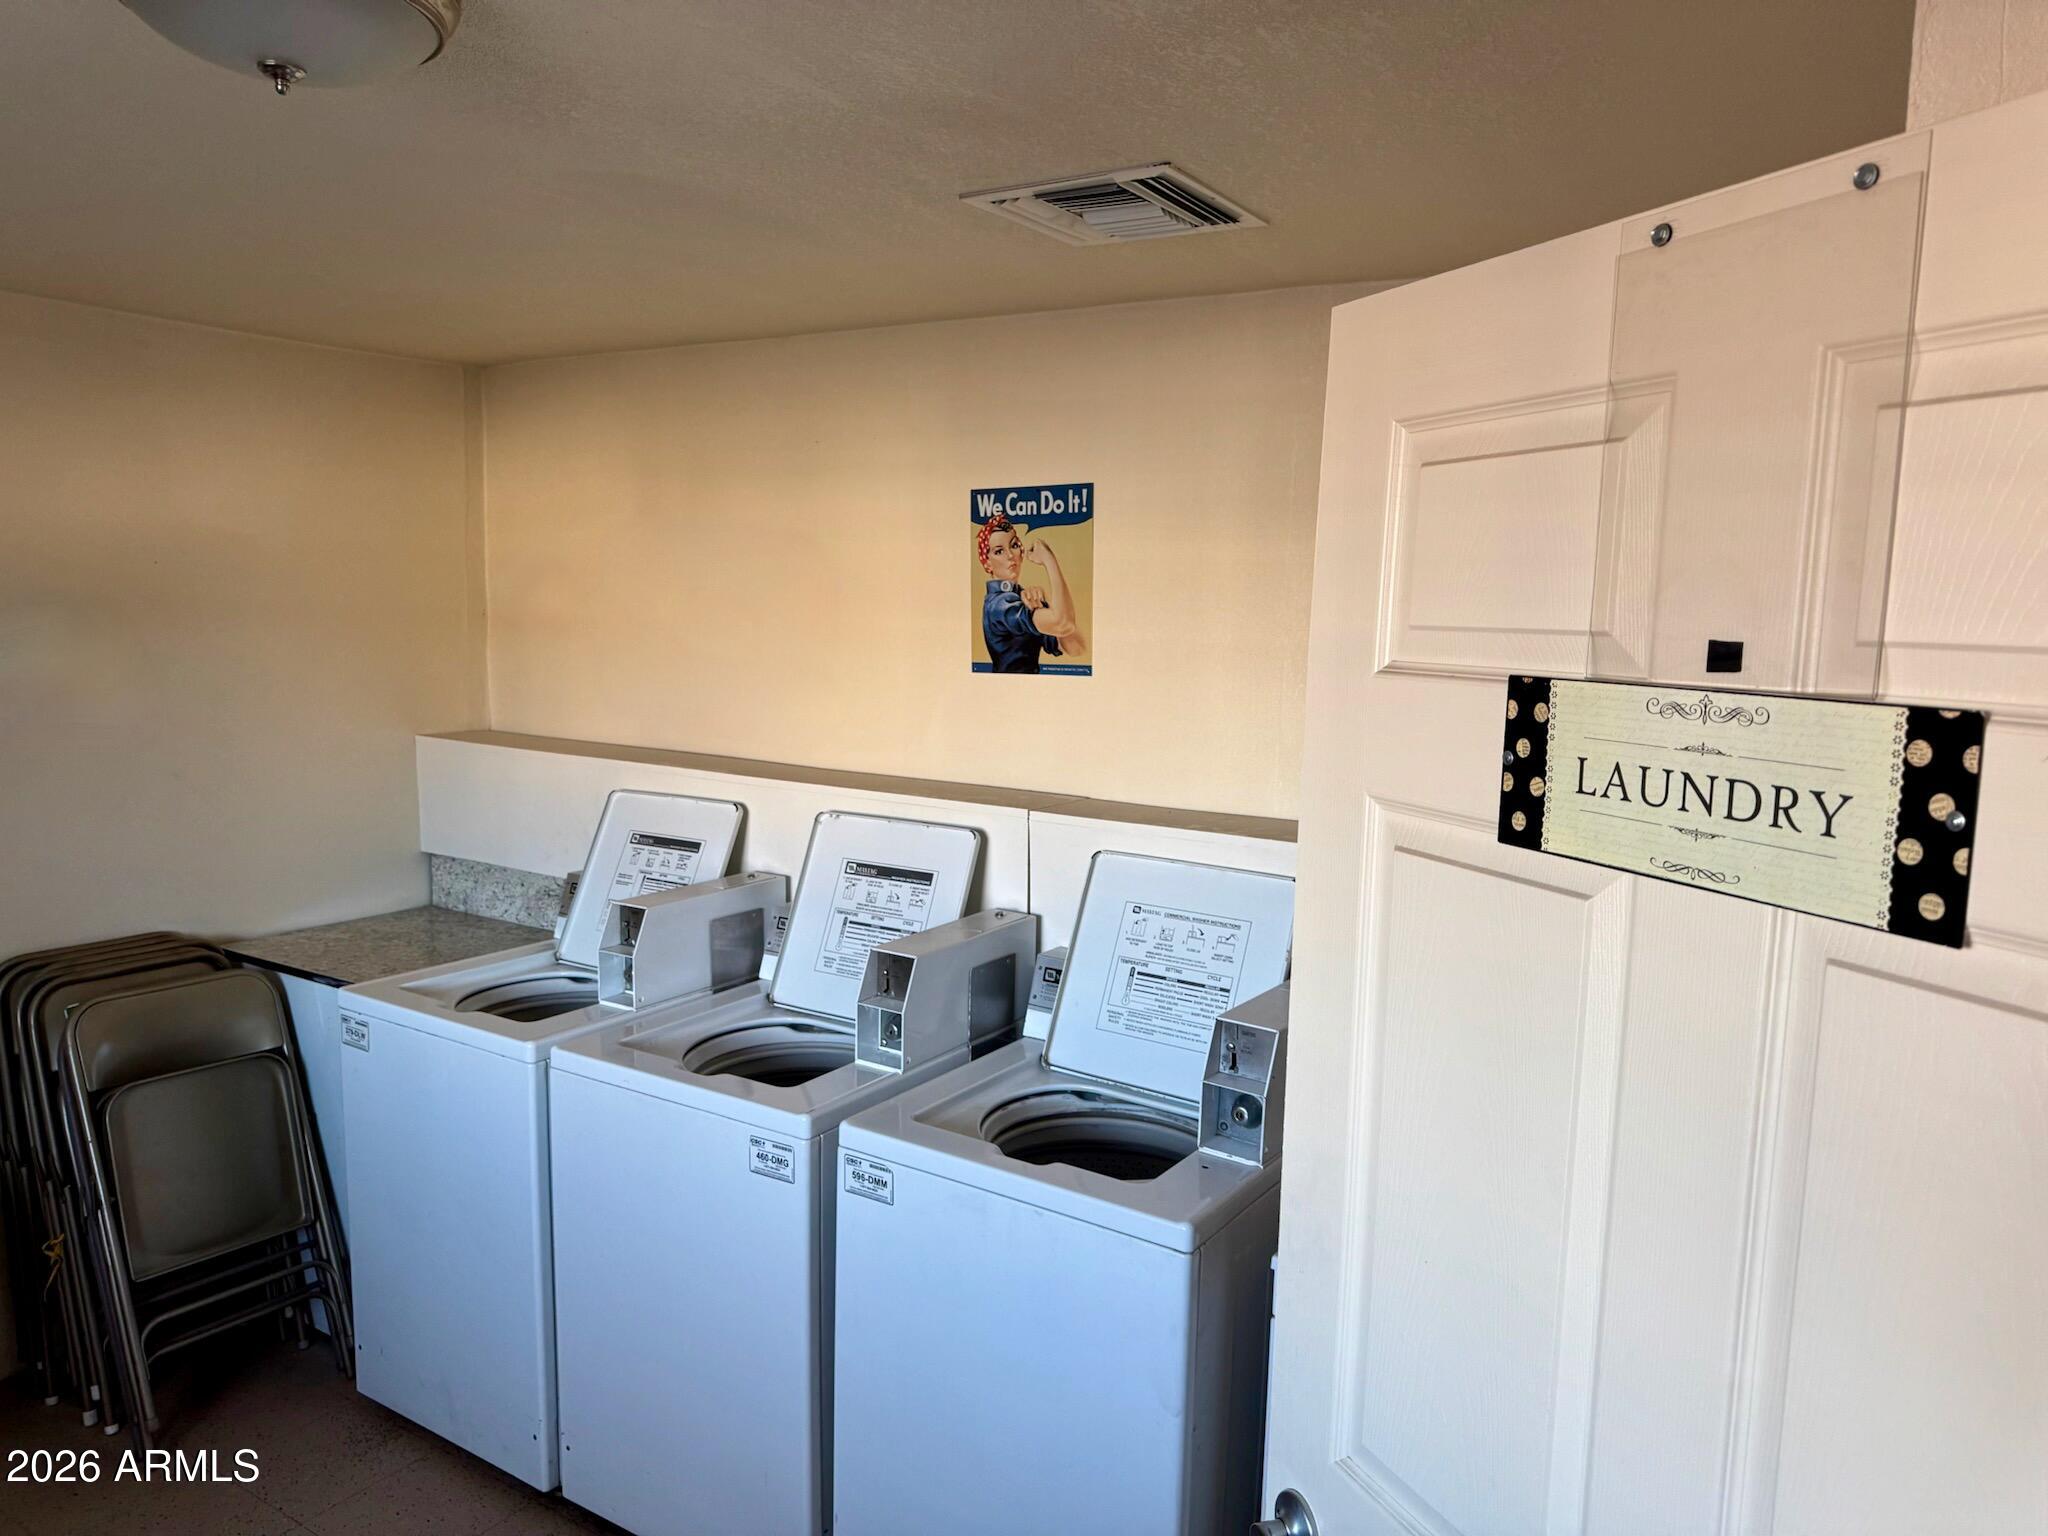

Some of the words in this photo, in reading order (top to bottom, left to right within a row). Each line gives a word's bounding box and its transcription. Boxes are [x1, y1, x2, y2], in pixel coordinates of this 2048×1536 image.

[977, 494, 1003, 517] We
[1005, 492, 1037, 516] Can
[1040, 490, 1064, 515] Do
[1068, 488, 1088, 514] It!
[1575, 756, 1853, 839] LAUNDRY
[1120, 958, 1149, 968] TEMPERATURE
[1165, 966, 1183, 975] SETTING
[1207, 974, 1221, 982] CYCLE
[756, 1152, 789, 1168] 460-DMG
[852, 1171, 888, 1189] 596-DMM
